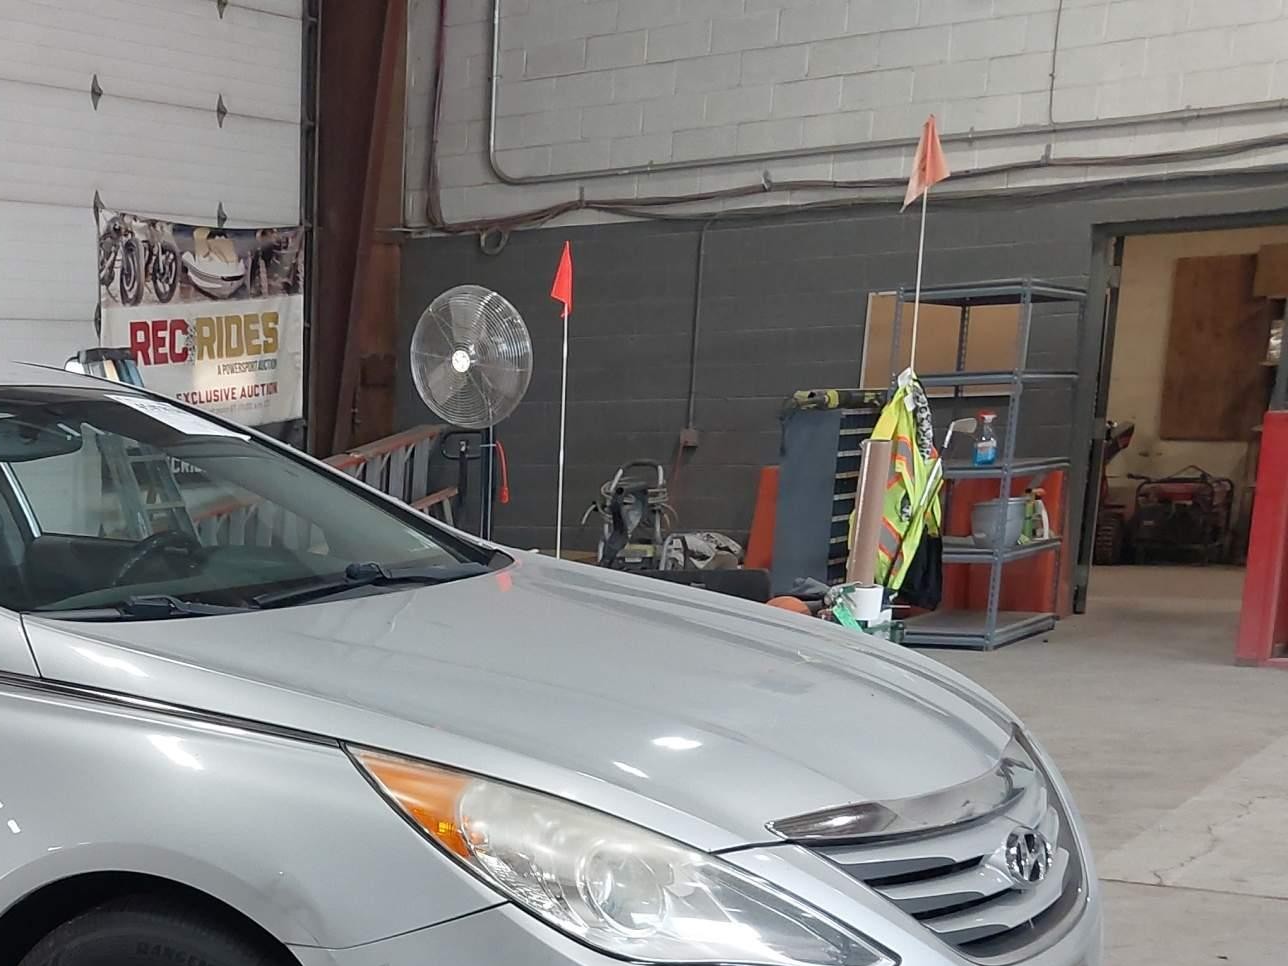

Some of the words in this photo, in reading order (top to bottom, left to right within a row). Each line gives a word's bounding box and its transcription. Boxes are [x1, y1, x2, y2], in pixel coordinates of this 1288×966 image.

[129, 319, 189, 366] REC
[195, 311, 280, 361] RIDES
[222, 361, 258, 375] POWERSPORT
[176, 387, 238, 405] EXCLUSIVE
[240, 382, 278, 398] AUCTION
